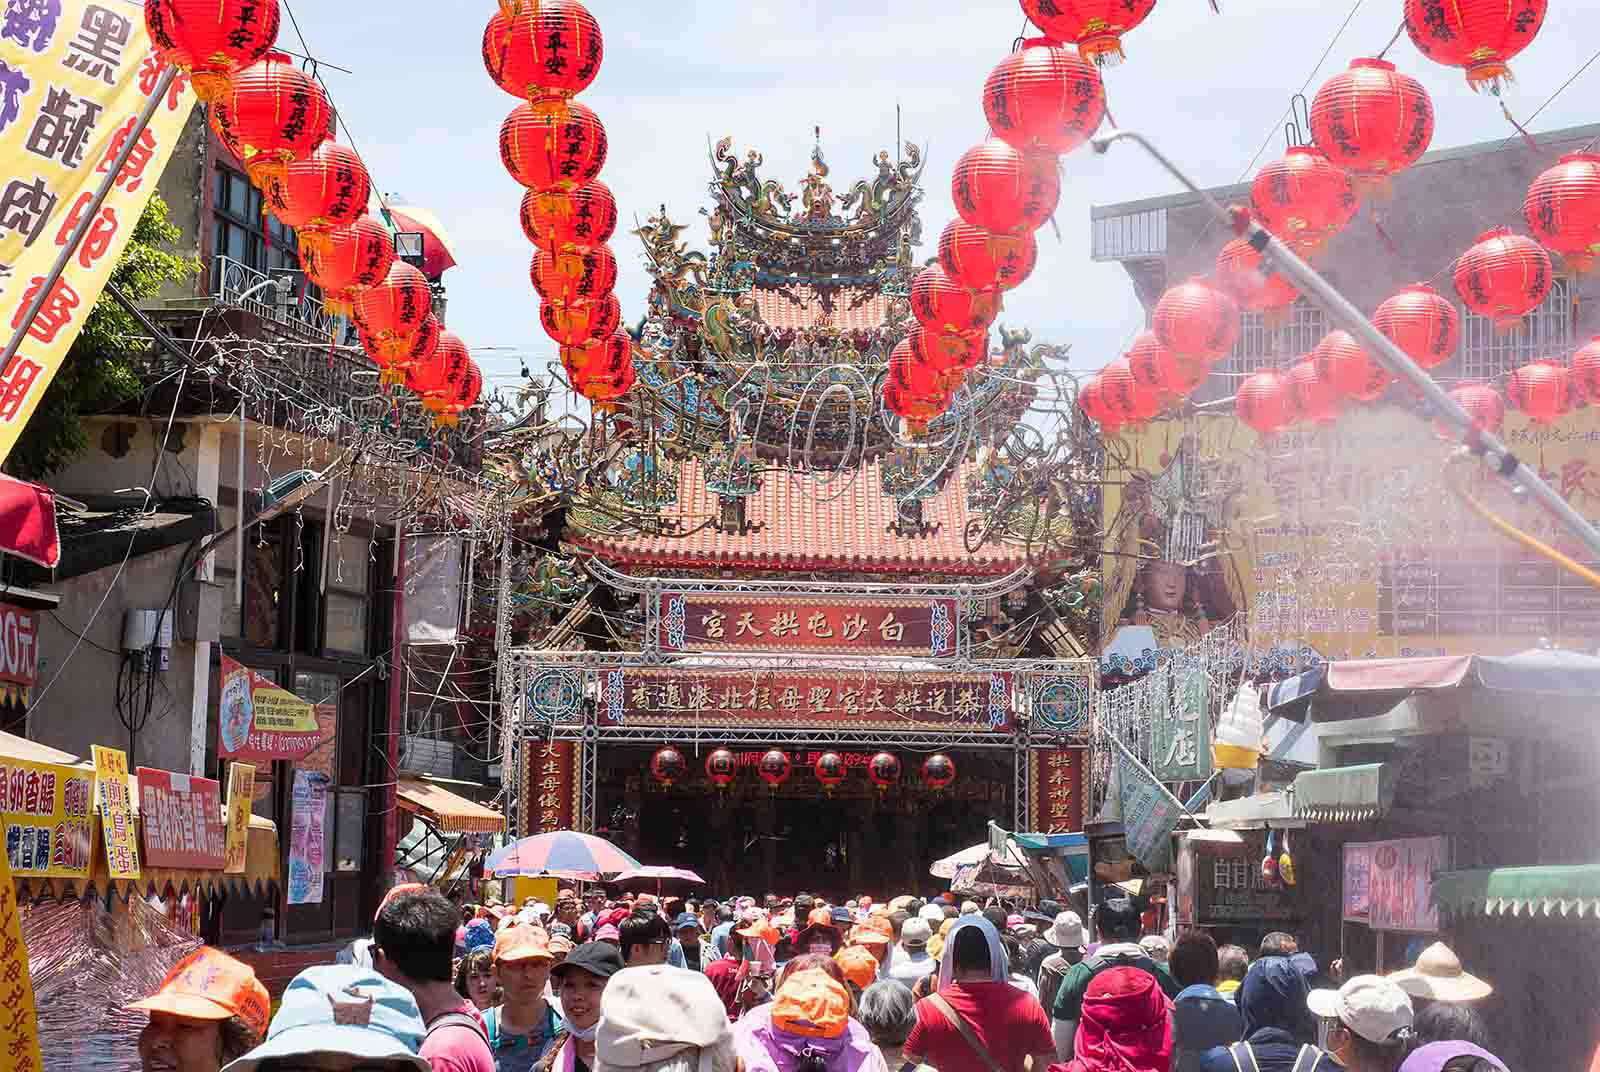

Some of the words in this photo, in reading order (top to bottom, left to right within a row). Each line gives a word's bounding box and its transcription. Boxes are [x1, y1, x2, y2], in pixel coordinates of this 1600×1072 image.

[701, 609, 906, 641] 白沙屯拱天宮
[538, 743, 562, 832] 天生母儀為
